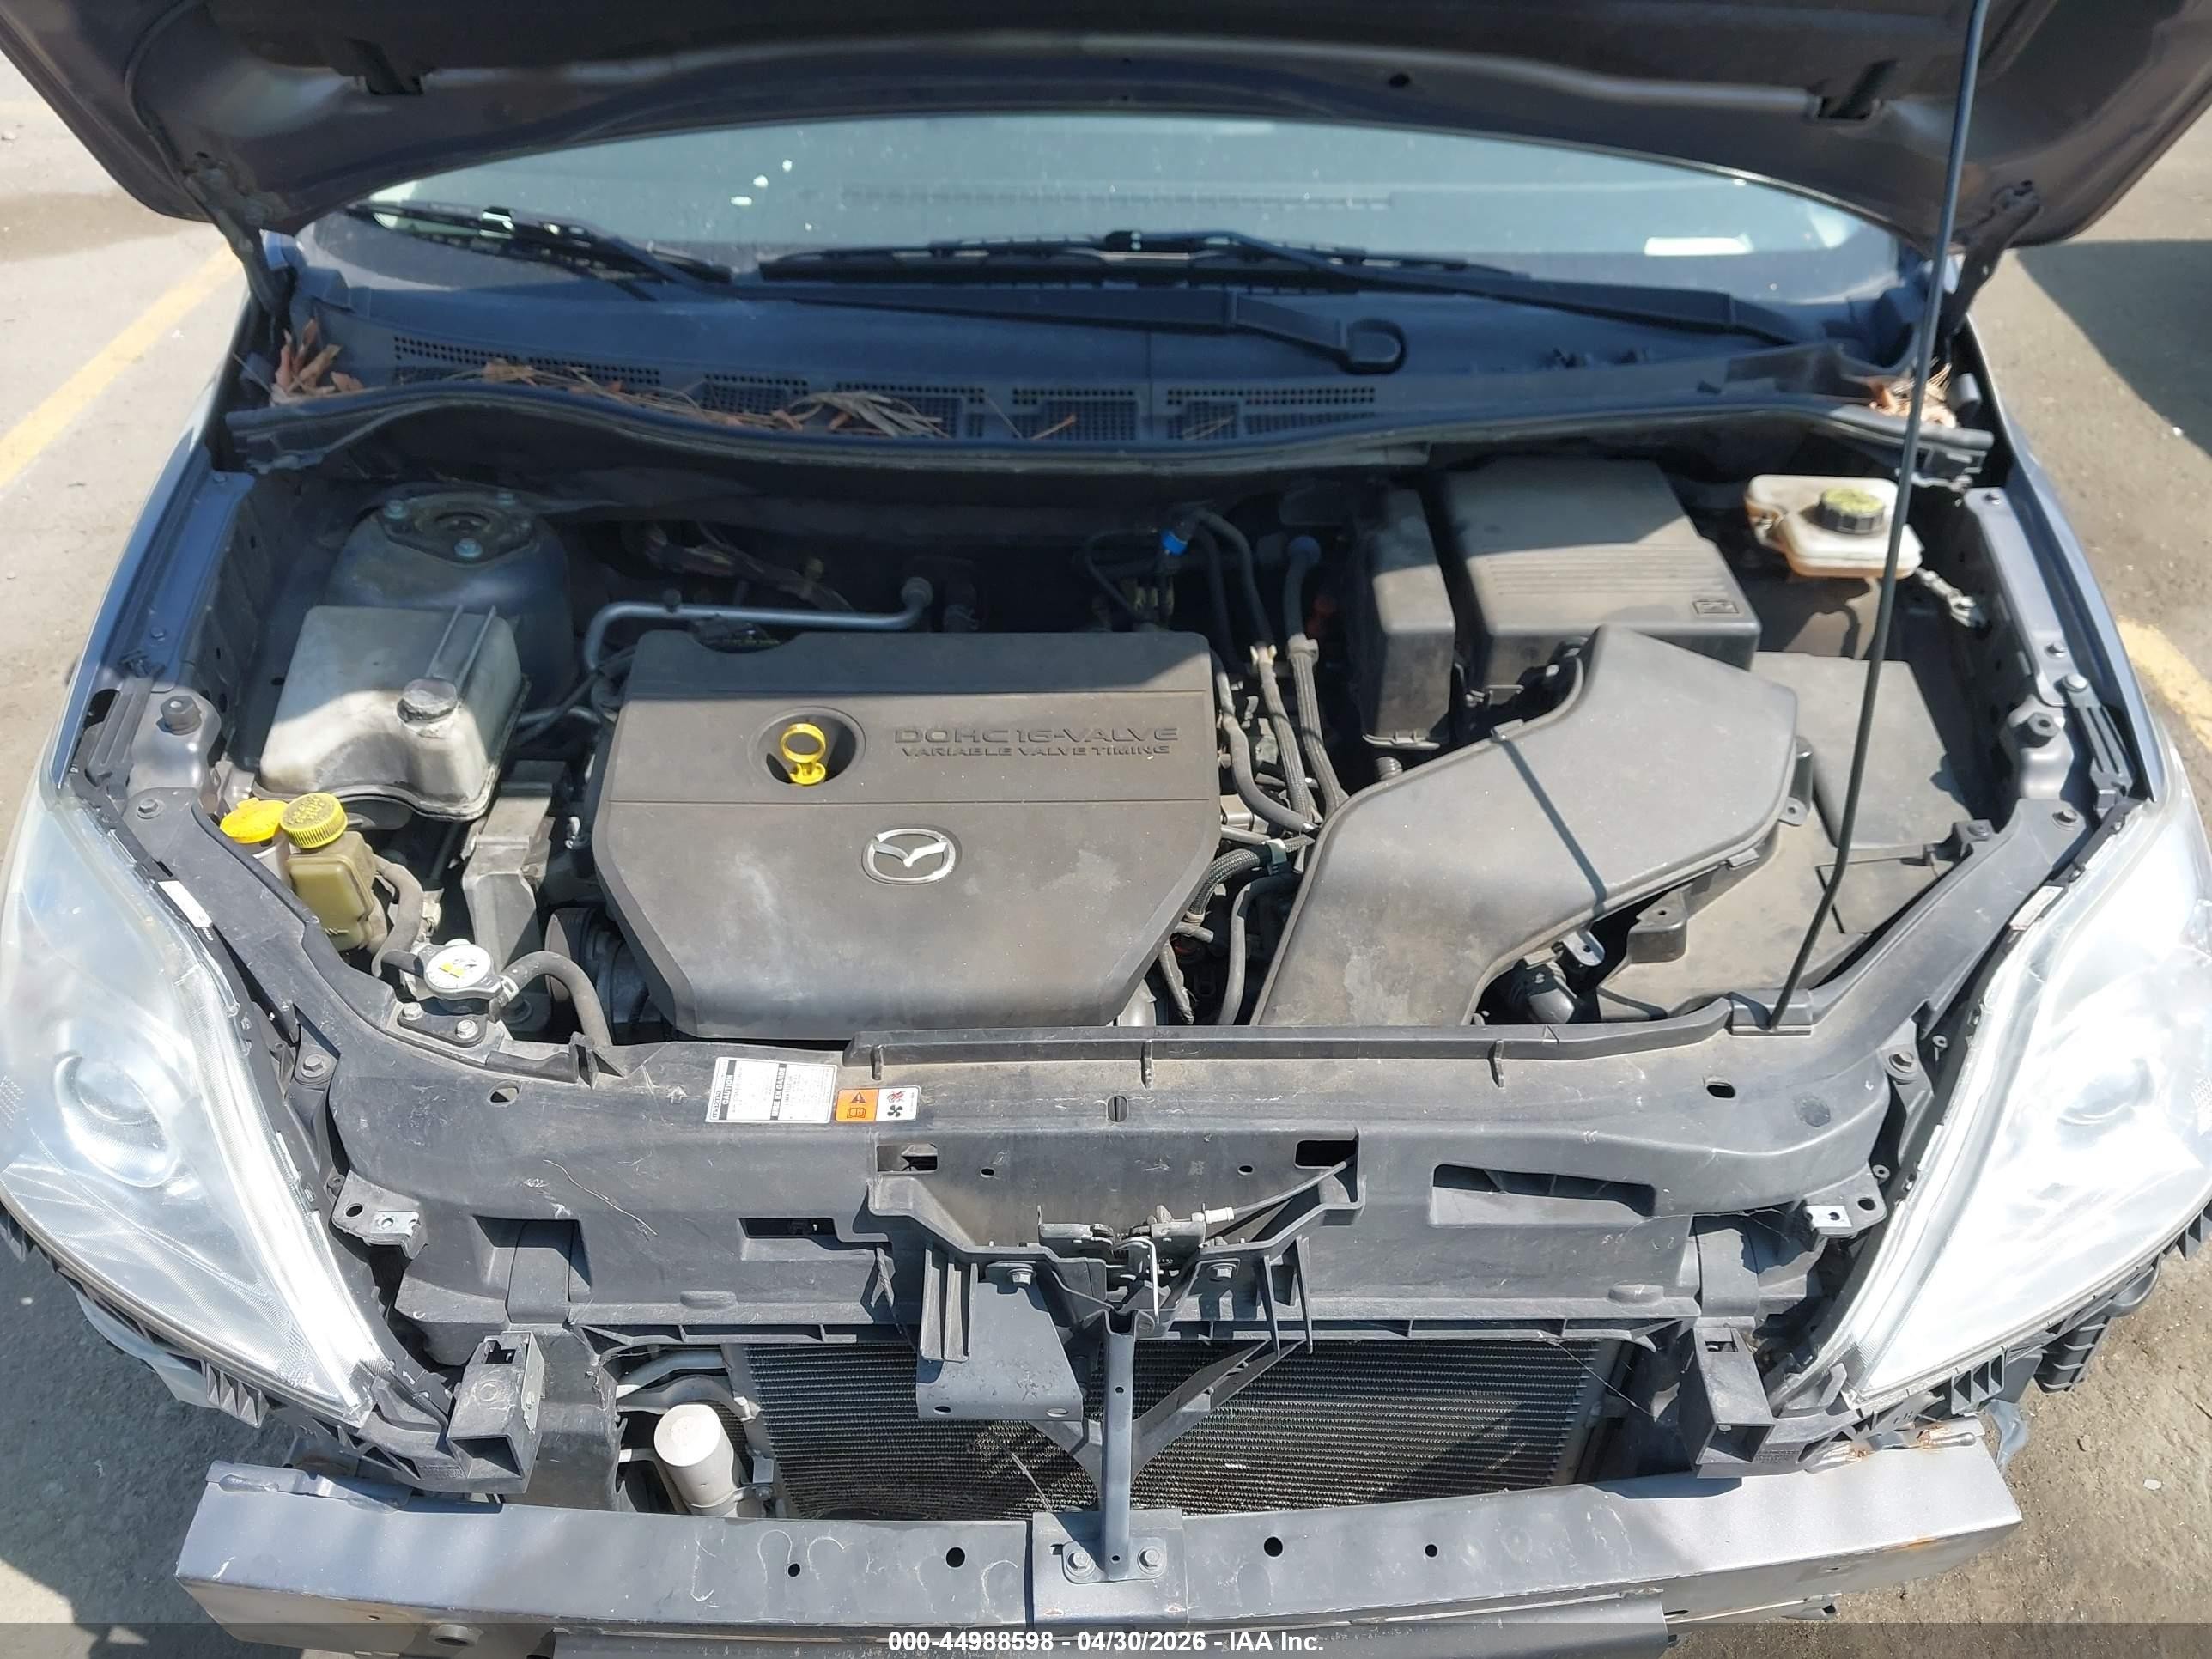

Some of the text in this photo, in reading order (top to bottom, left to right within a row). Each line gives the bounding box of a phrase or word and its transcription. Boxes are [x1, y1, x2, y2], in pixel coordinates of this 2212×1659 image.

[895, 728, 1179, 744] DOHC 16-VALVE
[902, 745, 1170, 757] VARIABLE VALVE TIMING
[721, 1074, 734, 1106] CAUTION
